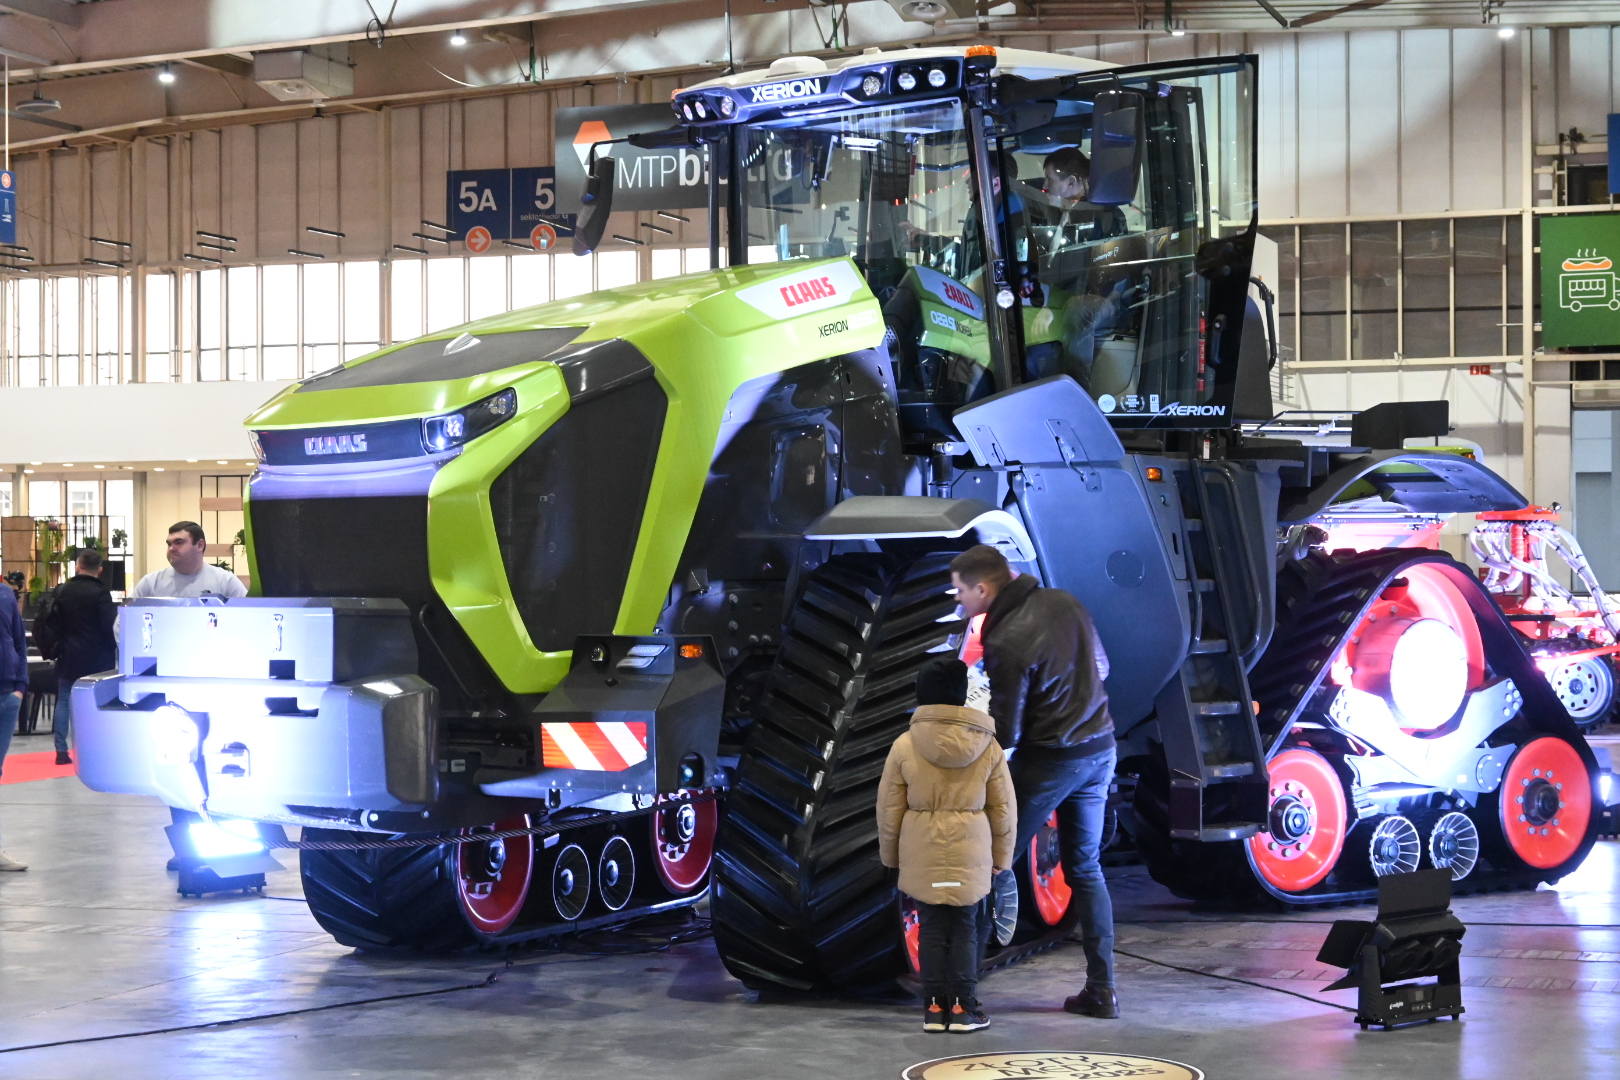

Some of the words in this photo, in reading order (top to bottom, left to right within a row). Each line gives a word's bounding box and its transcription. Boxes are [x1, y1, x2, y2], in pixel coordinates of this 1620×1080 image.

[751, 78, 821, 102] XERION
[458, 181, 497, 212] 5A
[534, 178, 555, 210] 5
[779, 276, 837, 307] CLAAS
[818, 319, 849, 338] XERION
[1166, 405, 1225, 416] XERION
[304, 433, 368, 456] CLAAS
[953, 1055, 1090, 1071] ZŁOTY
[997, 1060, 1152, 1077] MEDAL
[1069, 1067, 1166, 1080] 2025
